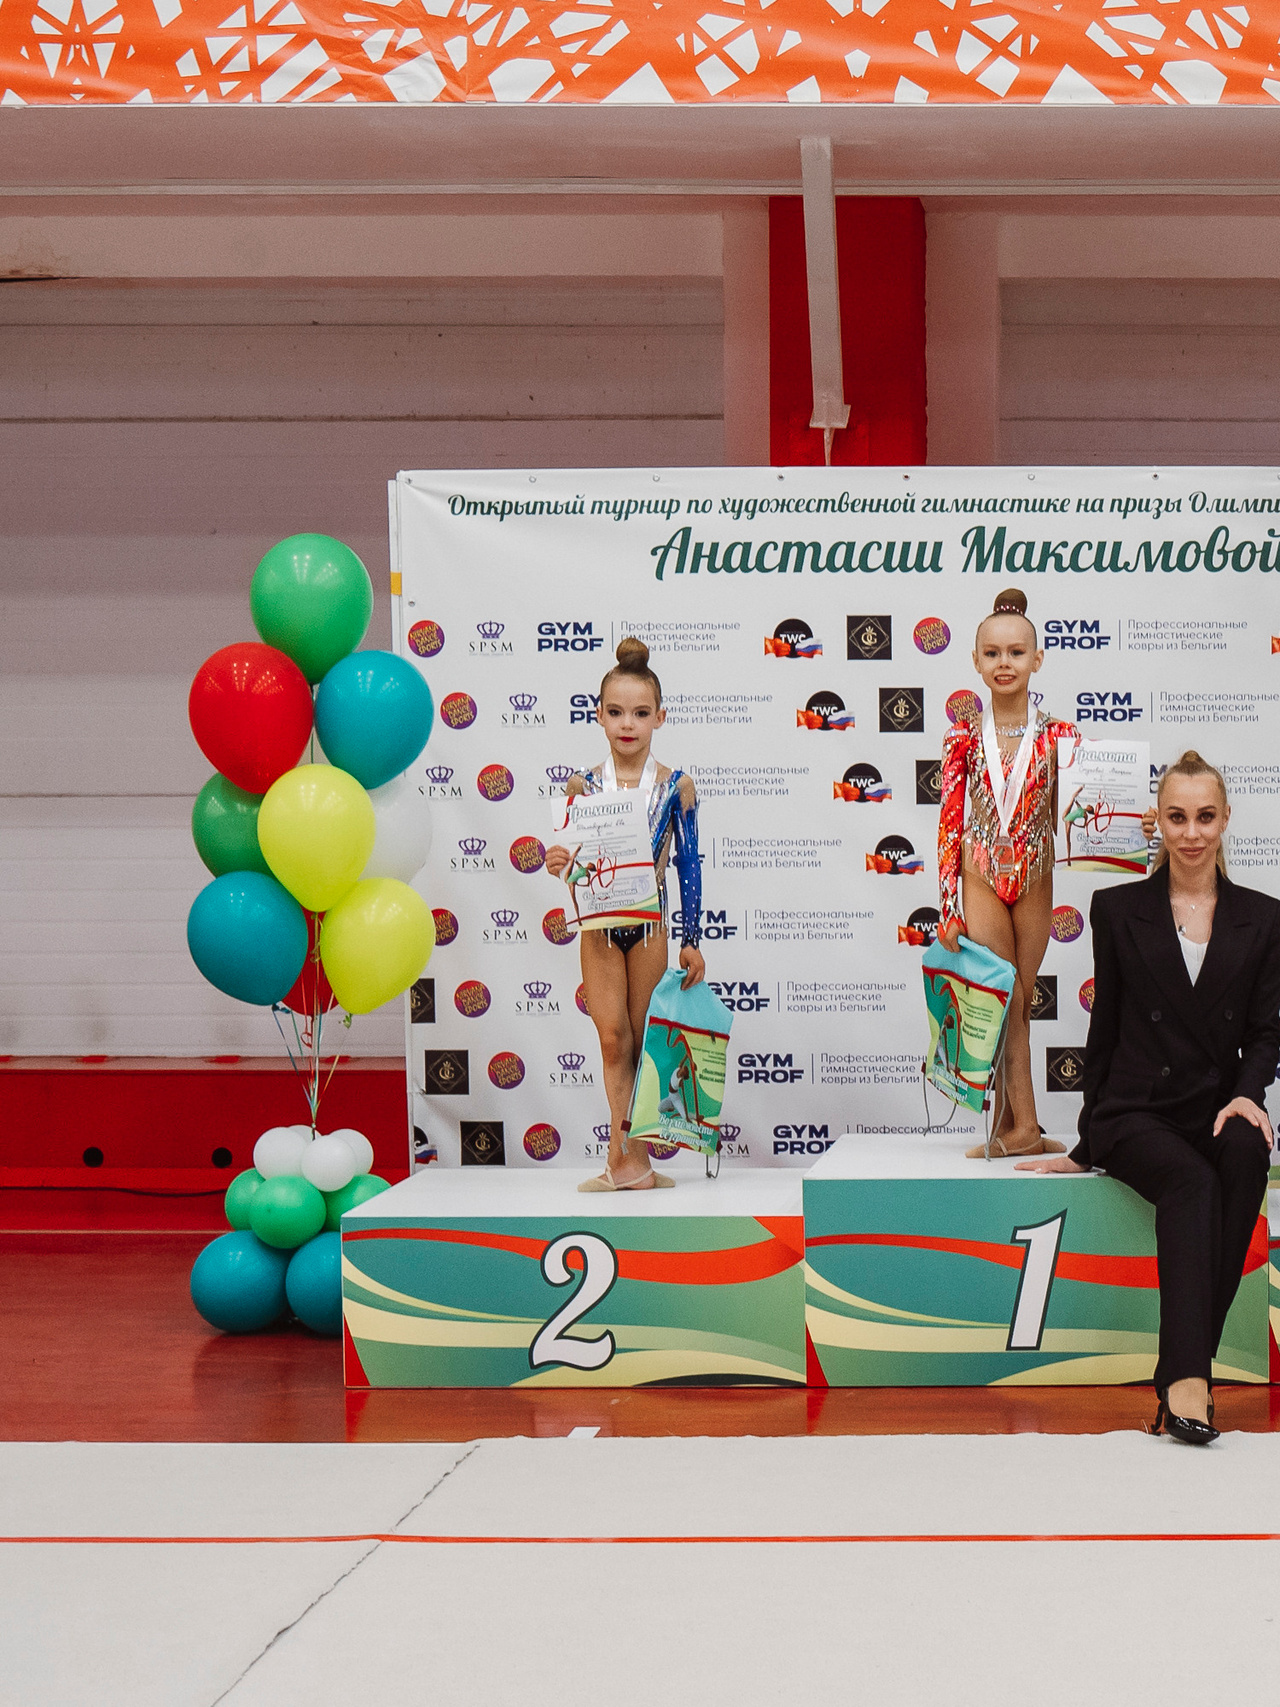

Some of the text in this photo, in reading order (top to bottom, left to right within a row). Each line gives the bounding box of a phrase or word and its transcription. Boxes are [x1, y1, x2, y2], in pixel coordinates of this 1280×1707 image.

[448, 494, 585, 522] Открытый
[590, 499, 681, 521] турнир
[686, 498, 713, 514] по
[718, 492, 915, 521] художественной
[921, 497, 1071, 513] гимнастике
[1076, 498, 1104, 513] на
[1109, 497, 1182, 519] призы
[650, 526, 943, 580] Анастасии
[538, 622, 592, 635] GYM
[621, 621, 740, 632] Профессиональные
[916, 621, 944, 638] NIRVANA
[1044, 620, 1098, 633] GYM
[1128, 619, 1248, 630] Профессиональные
[410, 624, 438, 640] NIRVANA
[921, 629, 944, 644] DANCE
[1128, 632, 1223, 640] гимнастические
[415, 632, 438, 646] DANCE
[538, 638, 604, 652] PROF
[924, 638, 948, 652] SPORTS
[1044, 636, 1110, 650] PROF
[1128, 640, 1227, 651] ковры из Бельгии
[418, 640, 442, 655] SPORTS
[468, 641, 513, 652] SPSM
[660, 642, 719, 652] из Бельгии
[570, 694, 600, 708] GY
[662, 694, 772, 704] рофессиональные
[1076, 692, 1131, 706] GYM
[1160, 692, 1280, 702] Профессиональные
[442, 696, 470, 712] NIRVANA
[1160, 704, 1255, 712] гимнастические
[448, 704, 471, 719] DANCE
[570, 710, 598, 724] PR
[1076, 708, 1142, 722] PROF
[450, 712, 474, 727] SPORTS
[501, 713, 546, 725] SPSM
[706, 715, 751, 724] Бельгии
[1160, 714, 1195, 724] ковры
[1213, 713, 1259, 722] Бельгии
[1073, 746, 1136, 765] Грамота
[479, 768, 508, 784] NIRVANA
[690, 765, 809, 776] Профессиональные
[484, 776, 508, 790] DANCE
[696, 778, 784, 786] имнастические
[418, 786, 462, 798] SPSM
[488, 784, 511, 799] SPORTS
[696, 786, 788, 797] овры из Бельгии
[567, 801, 632, 823] Грамота
[722, 837, 842, 848] Профессиональные
[722, 850, 817, 858] гимнастические
[451, 858, 495, 870] SPSM
[722, 858, 821, 869] ковры из Бельгии
[1229, 858, 1264, 868] ковры
[672, 910, 726, 924] GM
[755, 909, 874, 920] Профессиональные
[755, 922, 849, 930] гимнастические
[1054, 916, 1078, 932] DANCE
[483, 929, 528, 941] SPSM
[672, 926, 737, 940] POF
[755, 930, 853, 941] ковры из Бельгии
[1057, 925, 1080, 940] SPORTS
[456, 984, 484, 1000] NIRVANA
[787, 981, 906, 992] Профессиональные
[462, 992, 485, 1007] DANCE
[787, 994, 882, 1002] гимнастические
[464, 1000, 488, 1015] SPORTS
[516, 1001, 560, 1013] SPSM
[721, 998, 770, 1012] ROF
[787, 1002, 886, 1013] ковры из Бельгии
[490, 1055, 518, 1072] NIRVANA
[738, 1053, 792, 1067] GYM
[821, 1053, 926, 1064] Профессиональн
[821, 1065, 915, 1073] гимнастические
[498, 1072, 522, 1086] SPORTS
[550, 1073, 594, 1084] SPSM
[738, 1070, 804, 1083] PROF
[821, 1074, 920, 1085] ковры из Бельгии
[526, 1127, 554, 1144] NIRVANA
[773, 1125, 828, 1138] GYM
[534, 1144, 558, 1158] SPORTS
[1006, 1208, 1068, 1352] 1
[530, 1231, 619, 1370] 2
